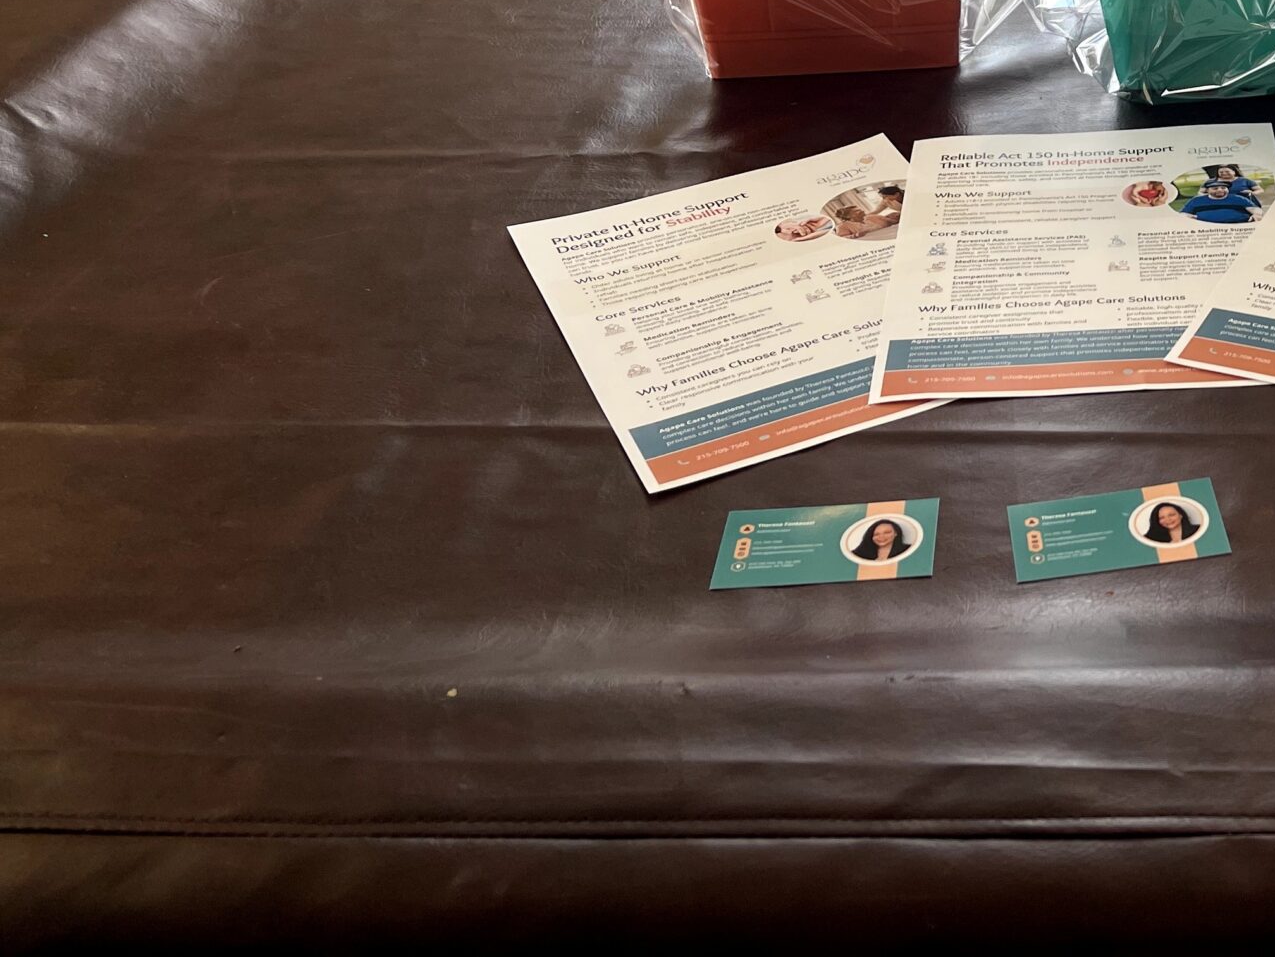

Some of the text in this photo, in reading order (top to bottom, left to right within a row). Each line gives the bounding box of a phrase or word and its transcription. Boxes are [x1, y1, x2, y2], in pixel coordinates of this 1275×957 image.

[940, 152, 994, 161] Reliable
[1027, 151, 1053, 159] 150
[1056, 150, 1114, 158] In-Home
[1118, 145, 1173, 156] Support
[940, 161, 969, 169] That
[1047, 154, 1144, 166] Independence
[986, 189, 1031, 197] Support
[551, 192, 748, 245] Private In-Home Support
[556, 205, 730, 253] Designed for Stability
[960, 228, 1008, 236] Services
[573, 254, 680, 284] Who We Support
[595, 296, 681, 322] Core Services
[917, 304, 947, 313] Why
[950, 302, 1001, 311] Families
[1005, 300, 1051, 308] Choose
[1054, 299, 1093, 307] Agape
[1128, 294, 1186, 302] Solutions
[635, 383, 668, 396] Why
[671, 366, 726, 386] Families
[728, 350, 776, 368] Choose
[780, 338, 818, 354] Agape
[821, 329, 850, 341] Care
